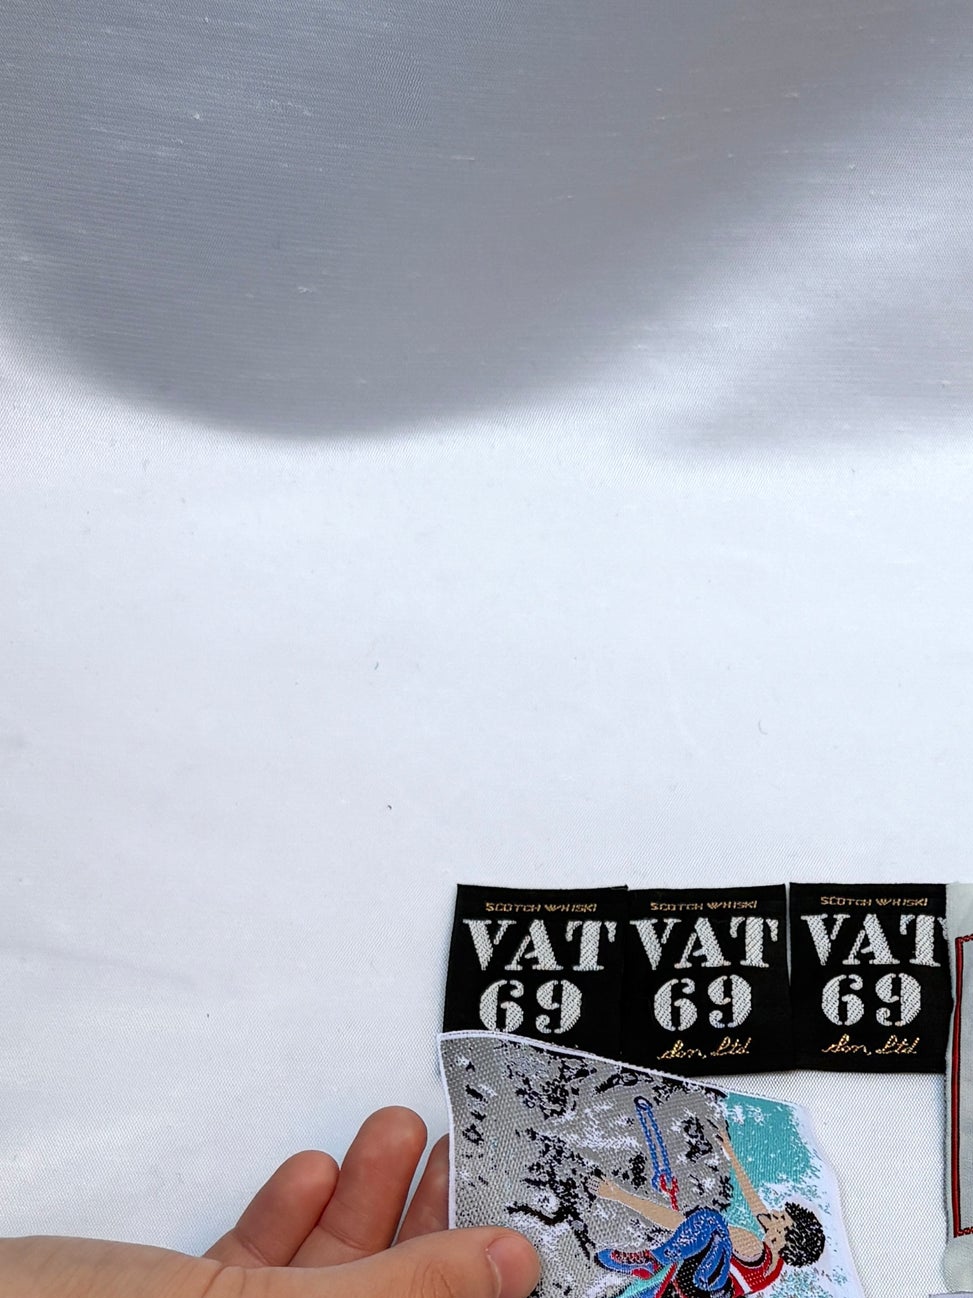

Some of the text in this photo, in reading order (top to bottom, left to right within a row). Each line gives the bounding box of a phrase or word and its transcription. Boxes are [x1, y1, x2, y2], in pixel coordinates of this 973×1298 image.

[485, 902, 597, 912] SCOTCH WHISKI
[650, 900, 758, 911] SCOTCH WHISKI
[820, 896, 928, 907] SCOTCH WHISKI
[463, 919, 618, 971] VAT
[629, 916, 779, 971] VAT
[801, 913, 949, 967] VAT
[479, 979, 582, 1034] 69
[653, 974, 752, 1031] 69
[821, 973, 922, 1026] 69
